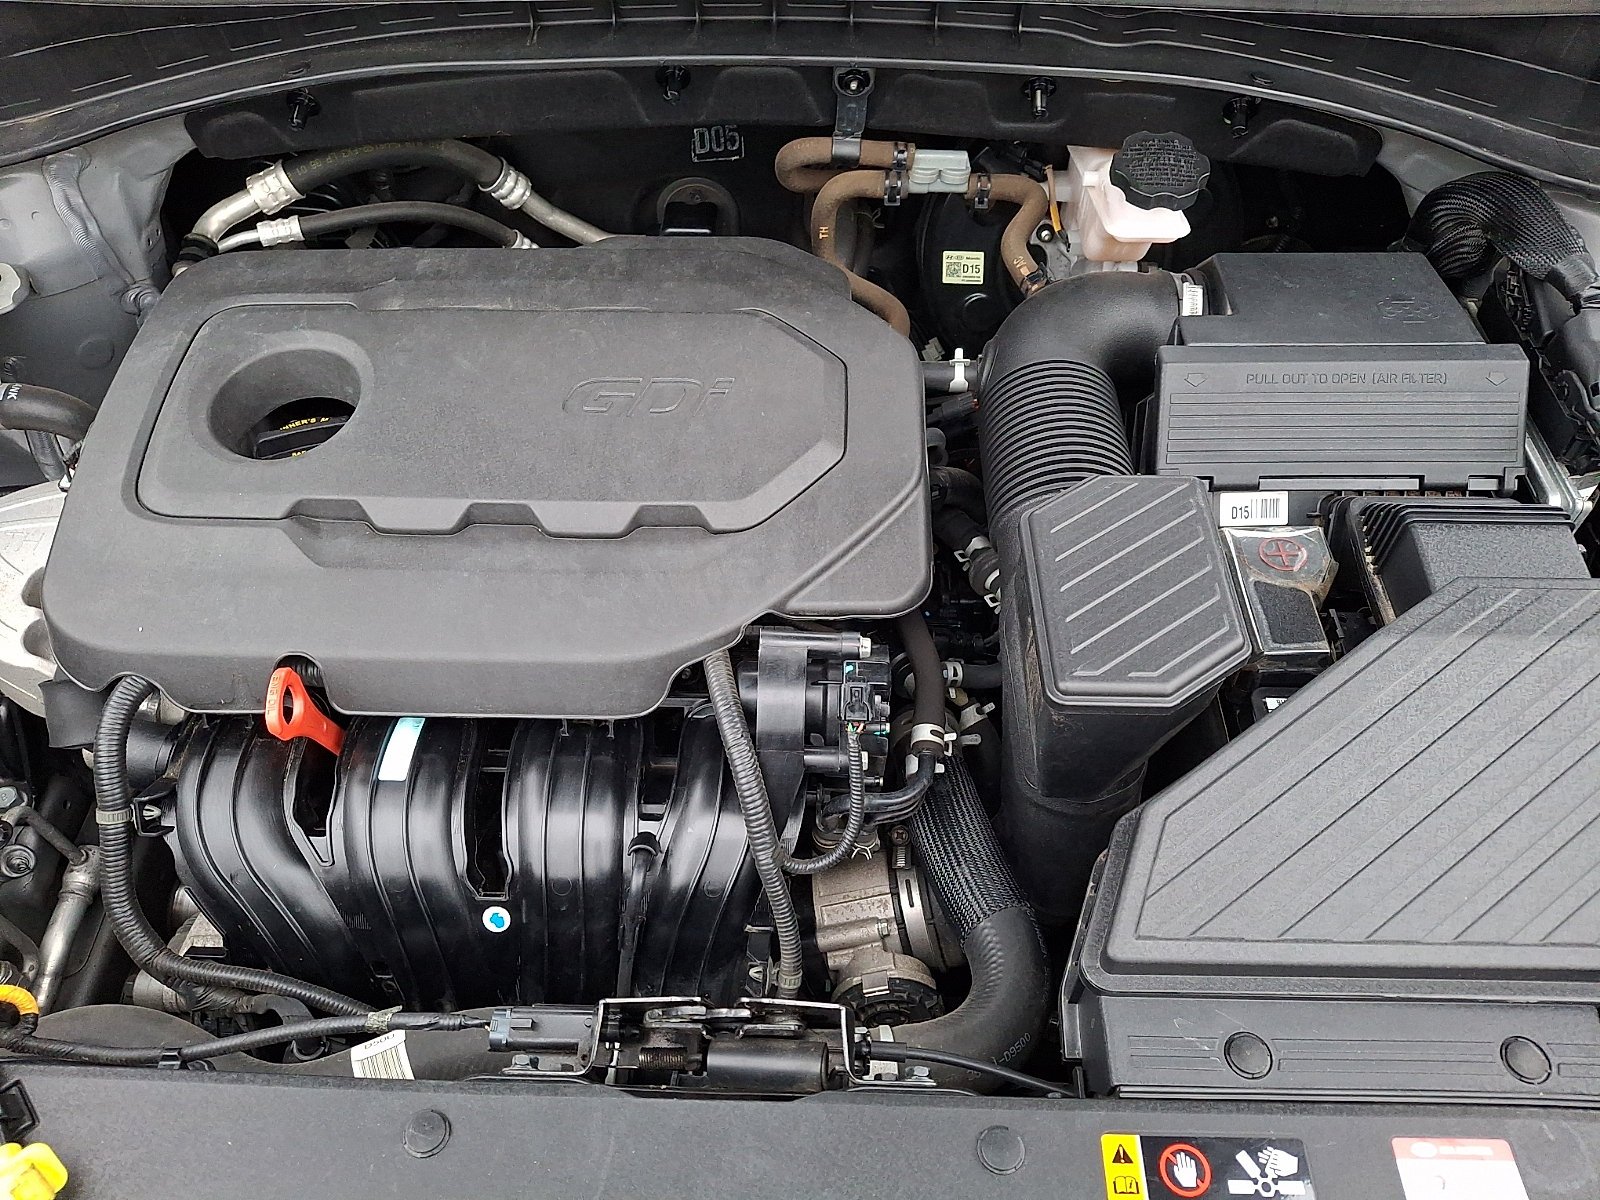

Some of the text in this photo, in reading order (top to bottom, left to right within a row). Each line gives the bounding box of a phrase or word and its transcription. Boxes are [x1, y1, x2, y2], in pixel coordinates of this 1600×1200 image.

[694, 125, 740, 154] D05
[819, 226, 829, 240] TH
[962, 264, 981, 274] D15
[1246, 373, 1279, 385] PULL
[1282, 373, 1309, 385] OUT
[1311, 373, 1329, 385] TO
[1331, 373, 1366, 385] OPEN
[562, 377, 736, 418] GDi
[1231, 505, 1250, 520] D15
